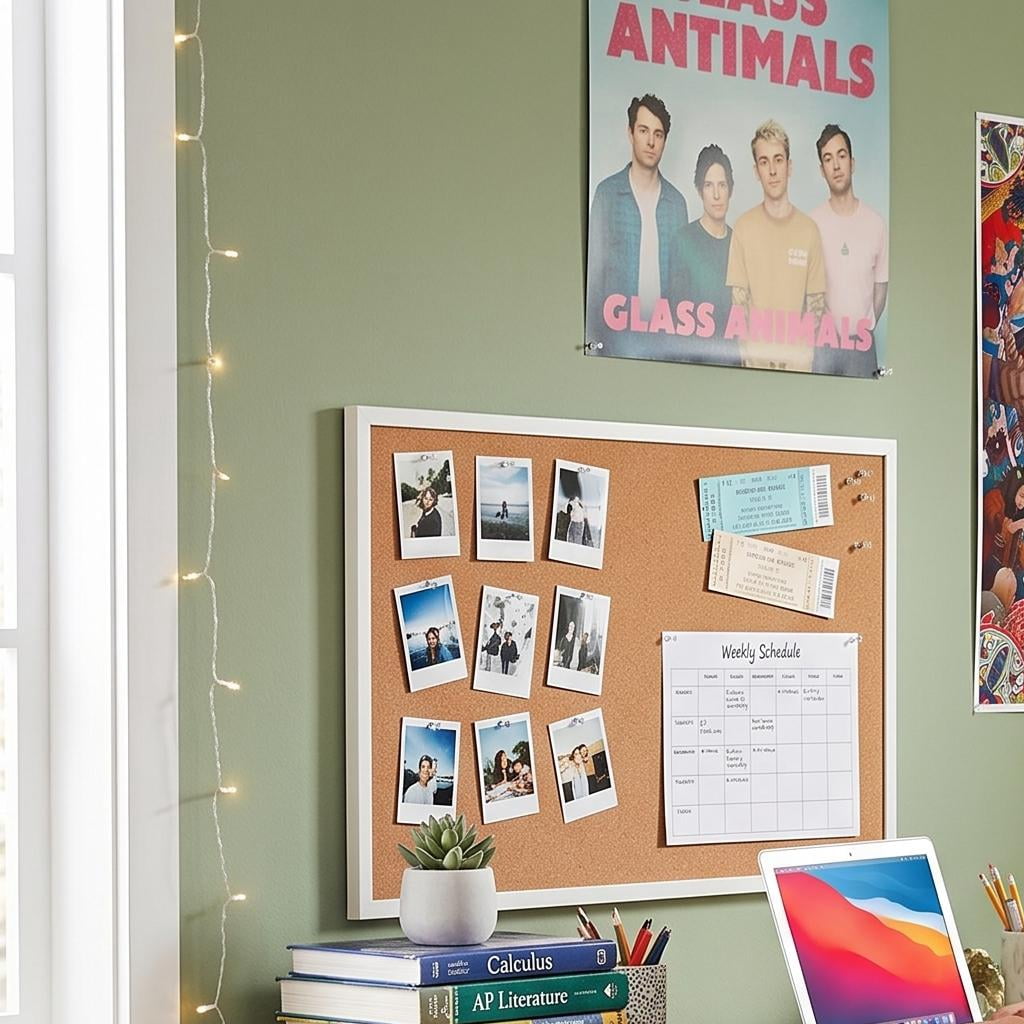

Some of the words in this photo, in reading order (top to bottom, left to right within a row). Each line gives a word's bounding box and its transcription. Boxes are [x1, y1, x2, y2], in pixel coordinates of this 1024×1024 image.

[606, 1, 876, 99] ANTIMALS
[603, 293, 716, 338] GLASS
[723, 303, 873, 352] ANIMALS
[722, 645, 755, 664] Weekly
[759, 643, 801, 660] Schedule
[487, 952, 553, 975] Calculus
[472, 992, 494, 1012] AP
[498, 990, 568, 1009] Literature
